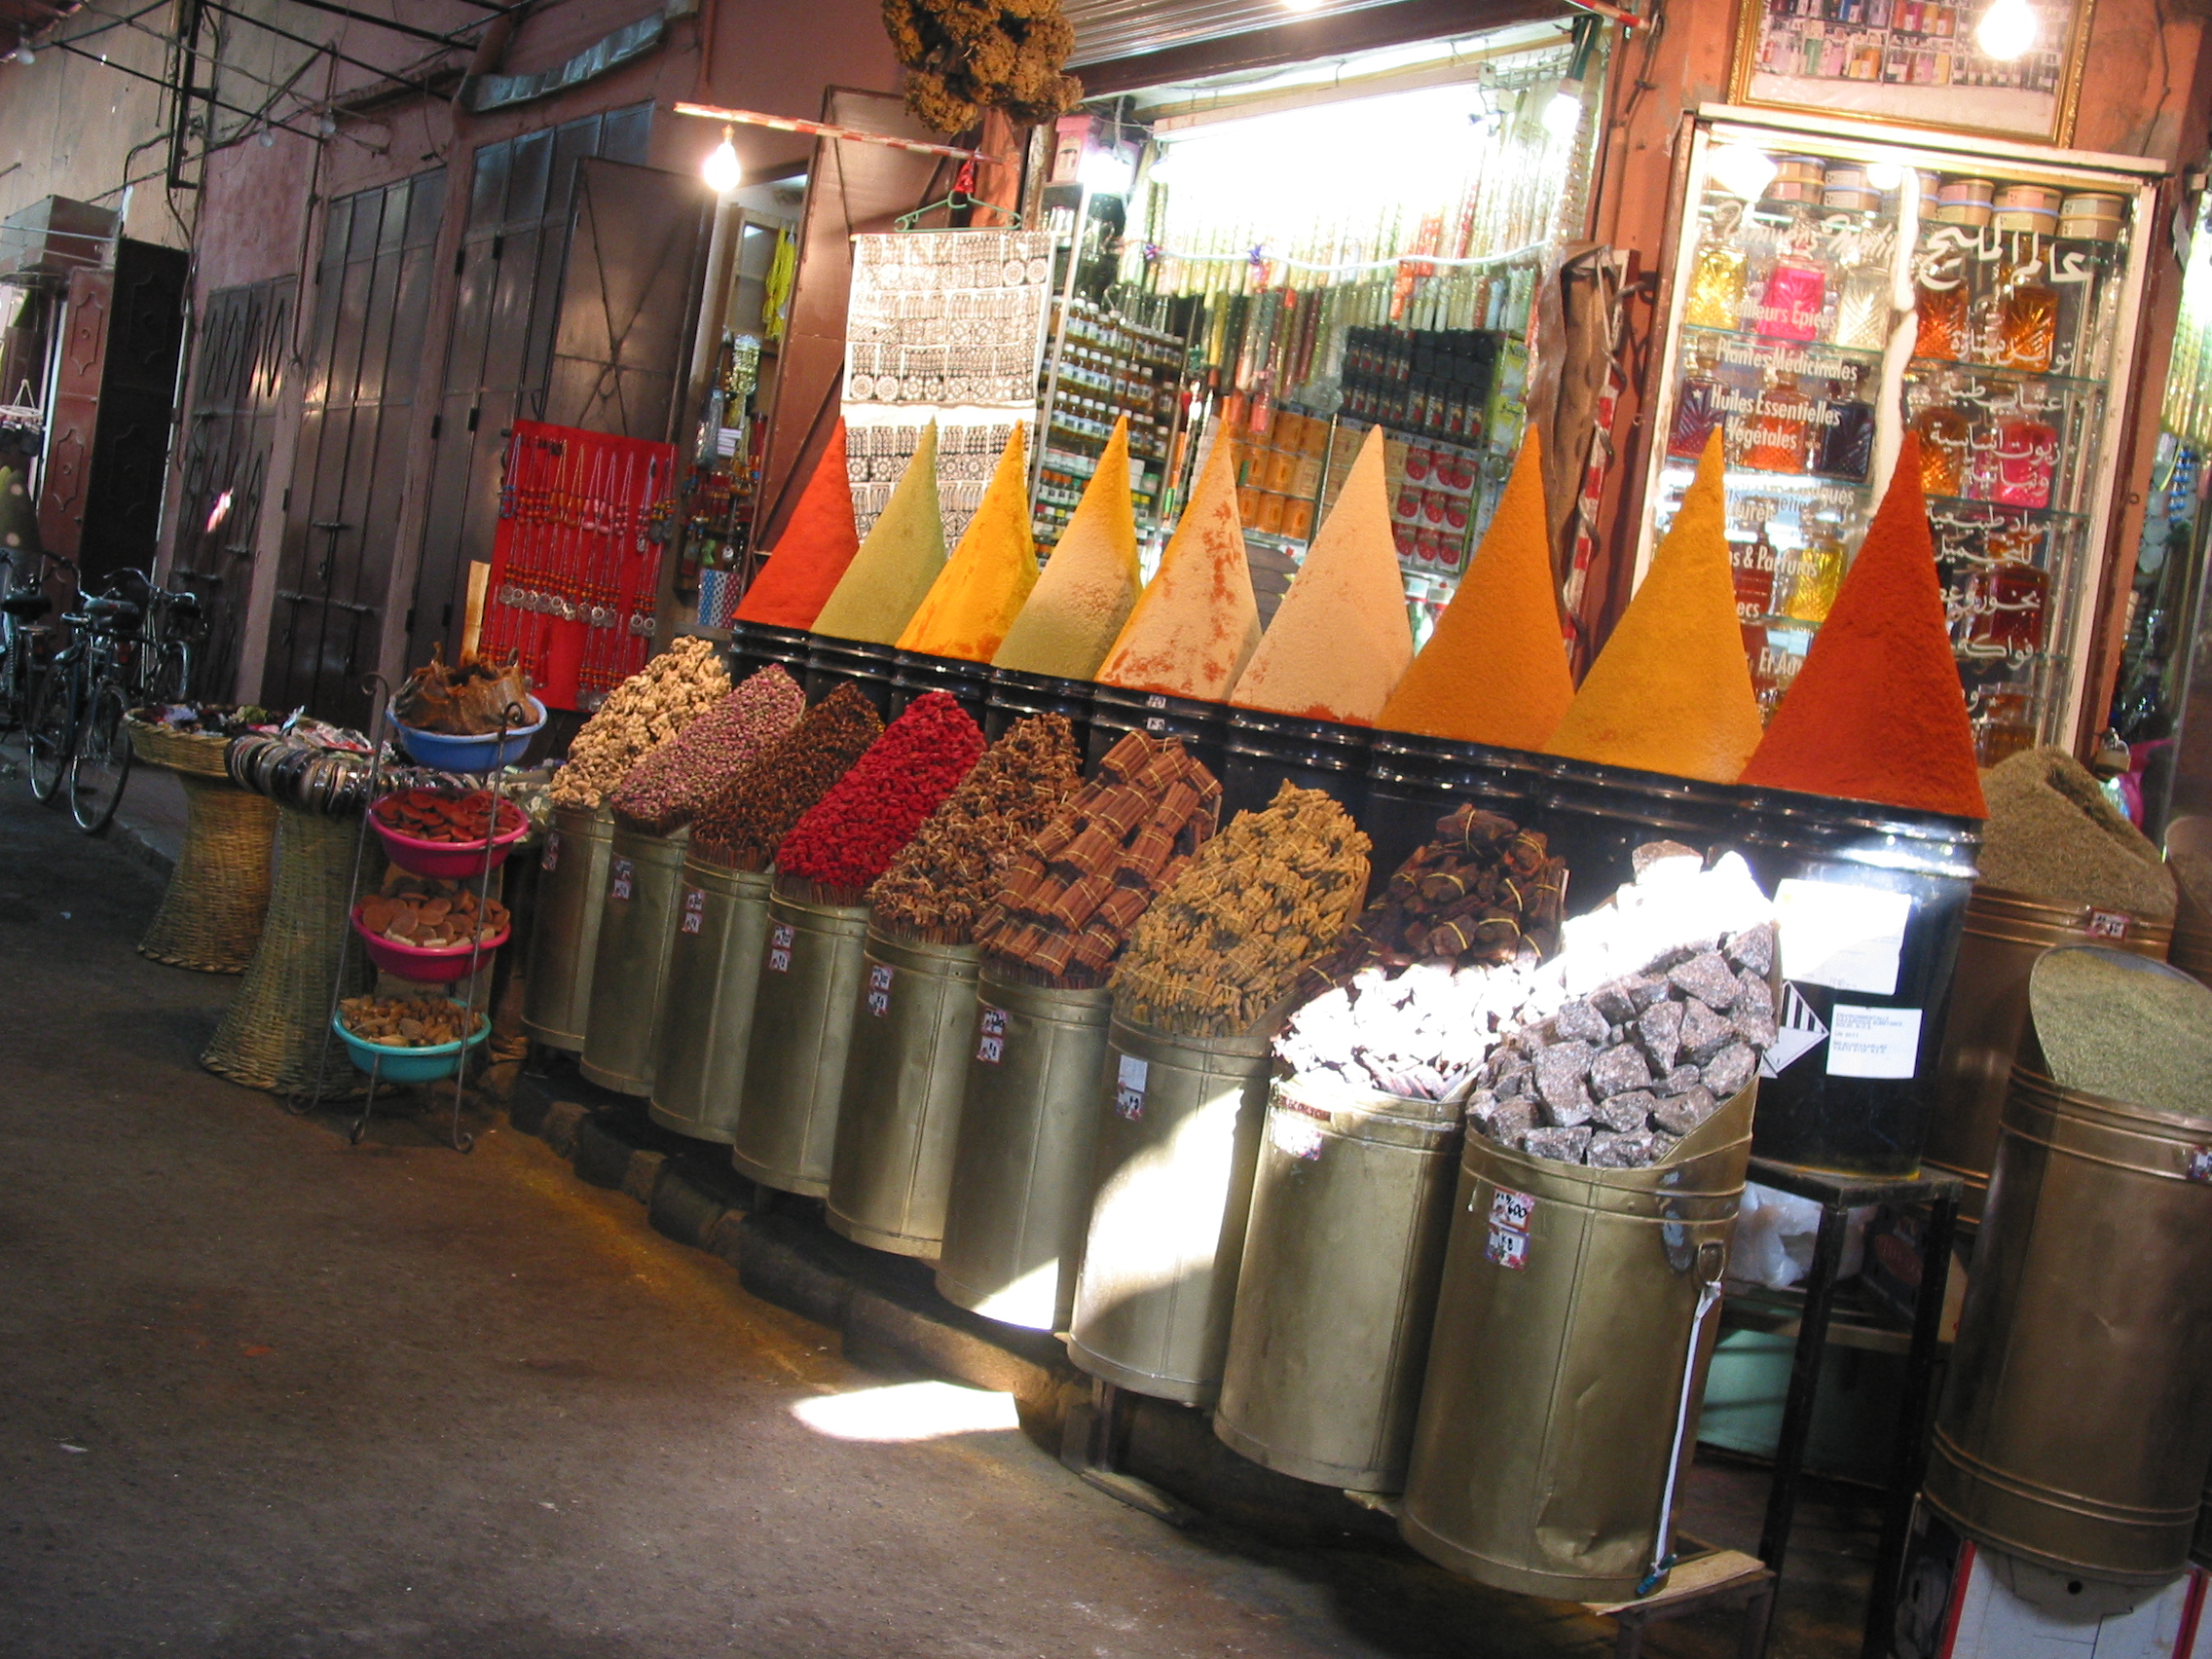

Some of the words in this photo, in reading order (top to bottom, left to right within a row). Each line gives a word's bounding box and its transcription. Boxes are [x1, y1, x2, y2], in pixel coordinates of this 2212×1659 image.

[1790, 299, 1837, 329] Epices
[1715, 336, 1772, 370] Plantes
[1772, 346, 1859, 382] Médicinales
[1710, 383, 1754, 414] Huiles
[1754, 389, 1842, 426] Essentielles
[1726, 414, 1798, 451] Végétales
[1743, 544, 1754, 569] &
[1755, 545, 1819, 577] Parfums
[1737, 601, 1760, 618] ecs
